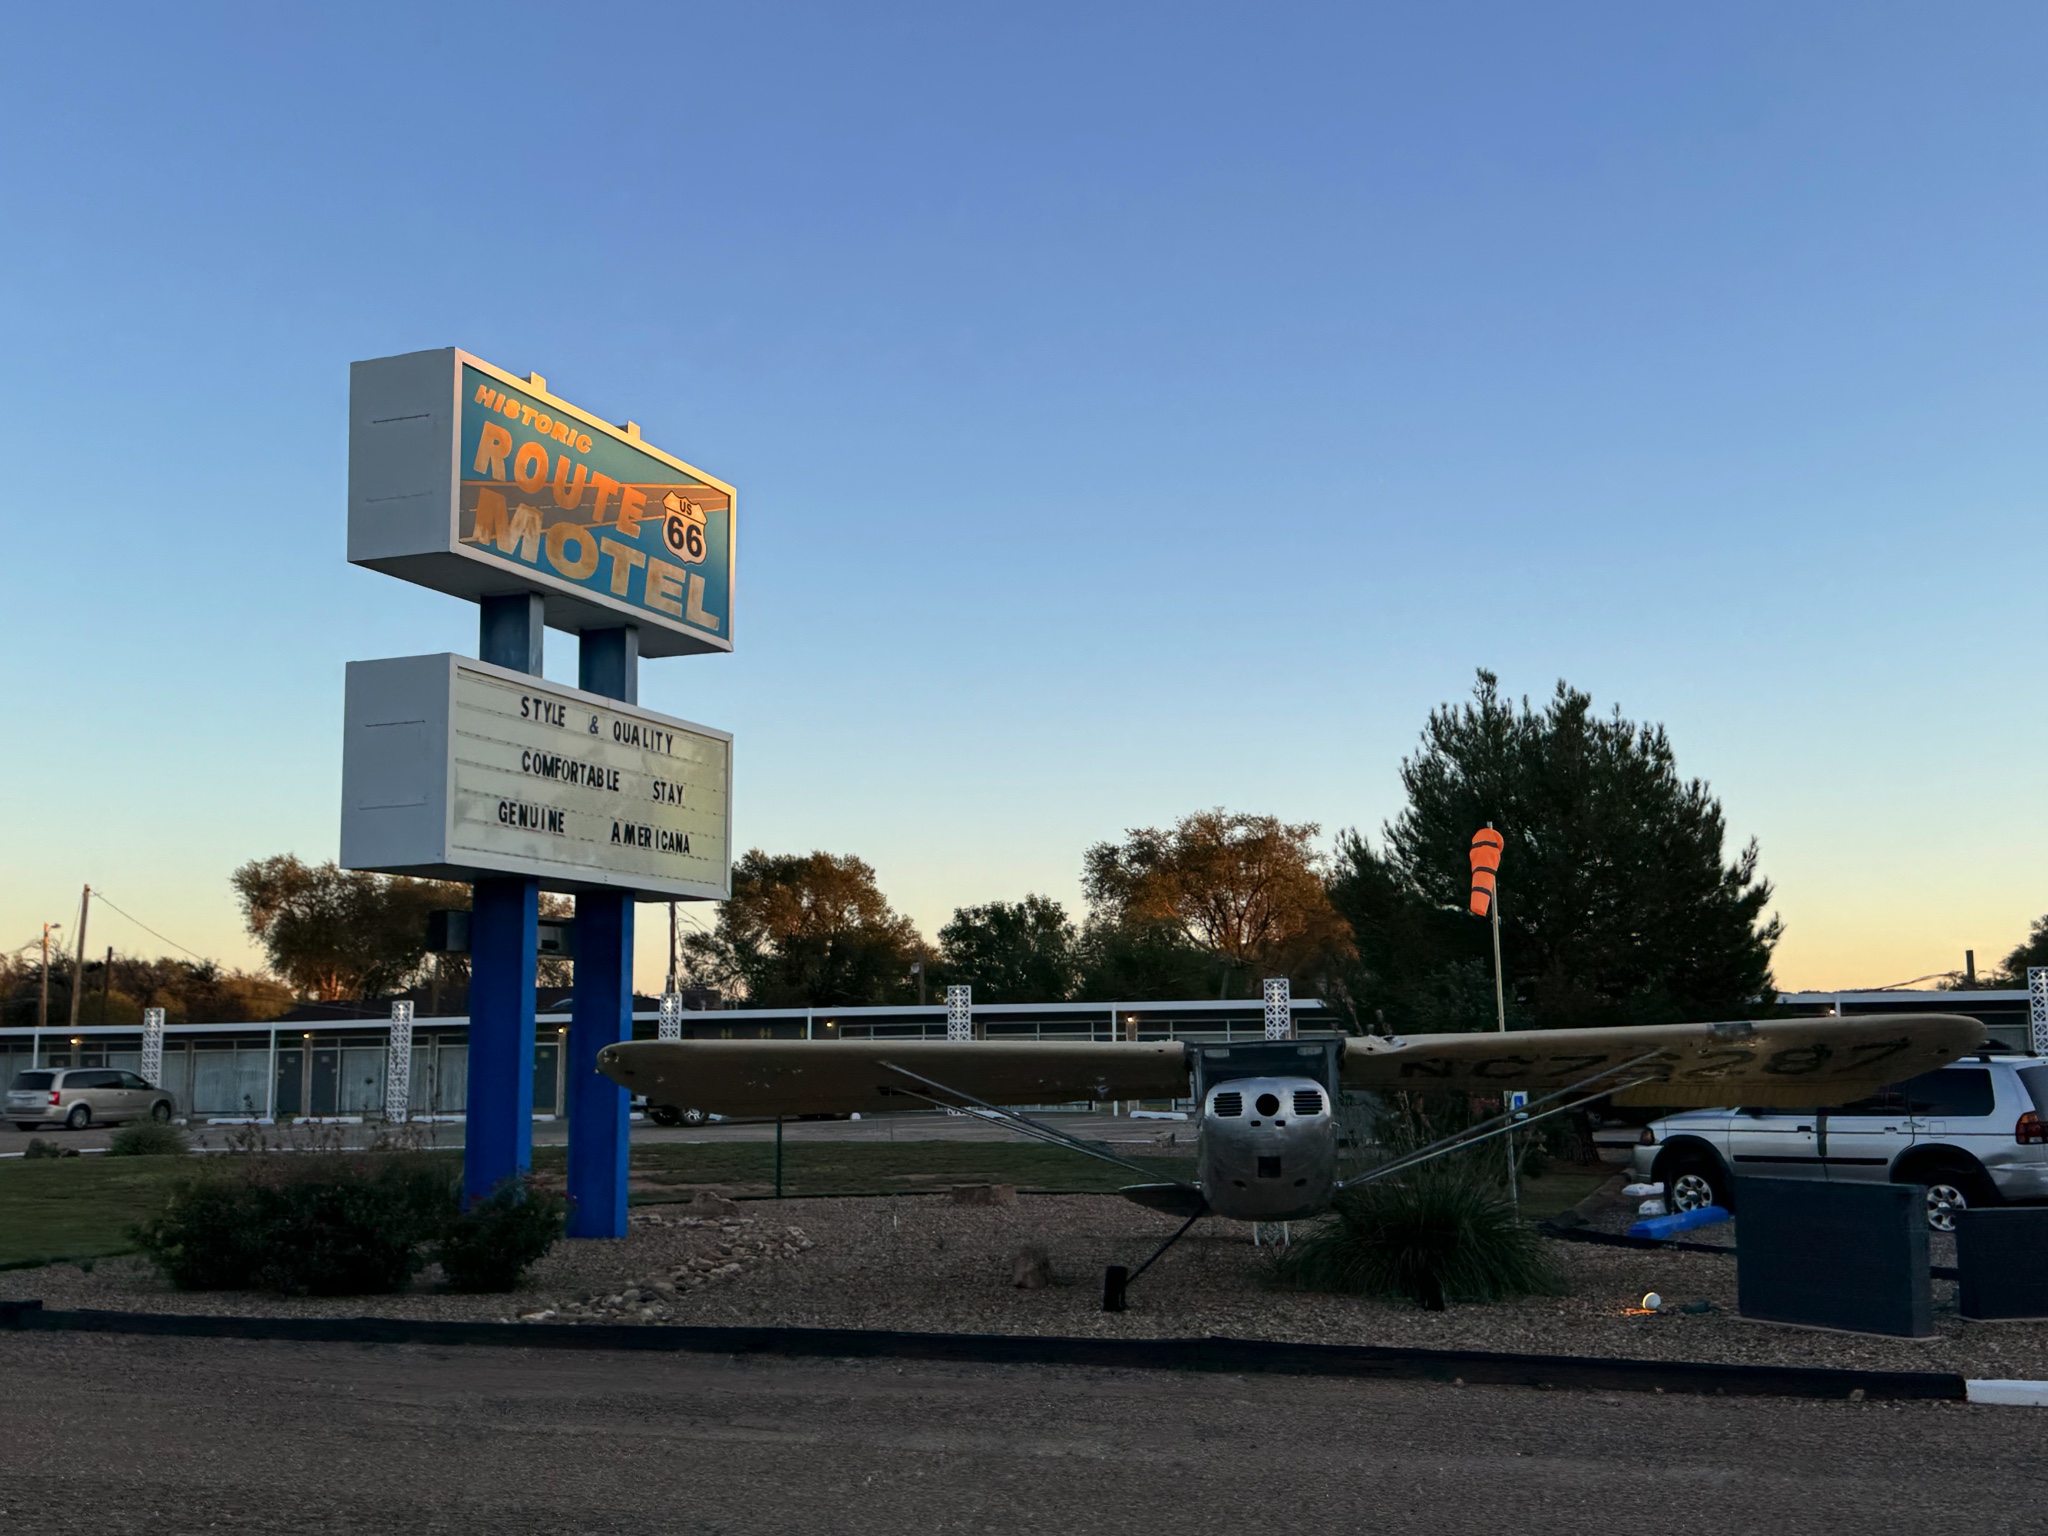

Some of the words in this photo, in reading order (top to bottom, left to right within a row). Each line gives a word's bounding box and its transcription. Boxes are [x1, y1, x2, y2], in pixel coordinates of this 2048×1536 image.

[474, 384, 592, 453] HISTORIC
[473, 421, 647, 539] ROUTE
[679, 500, 692, 515] US
[472, 487, 719, 631] MOTEL
[667, 516, 703, 557] 66
[520, 696, 566, 727] STYLE
[589, 715, 599, 735] &
[613, 720, 673, 754] QUALITY
[522, 751, 620, 792] COMFORTABLE
[653, 780, 684, 804] STAY
[498, 801, 565, 833] GENUINE
[611, 822, 690, 854] AMERICANA
